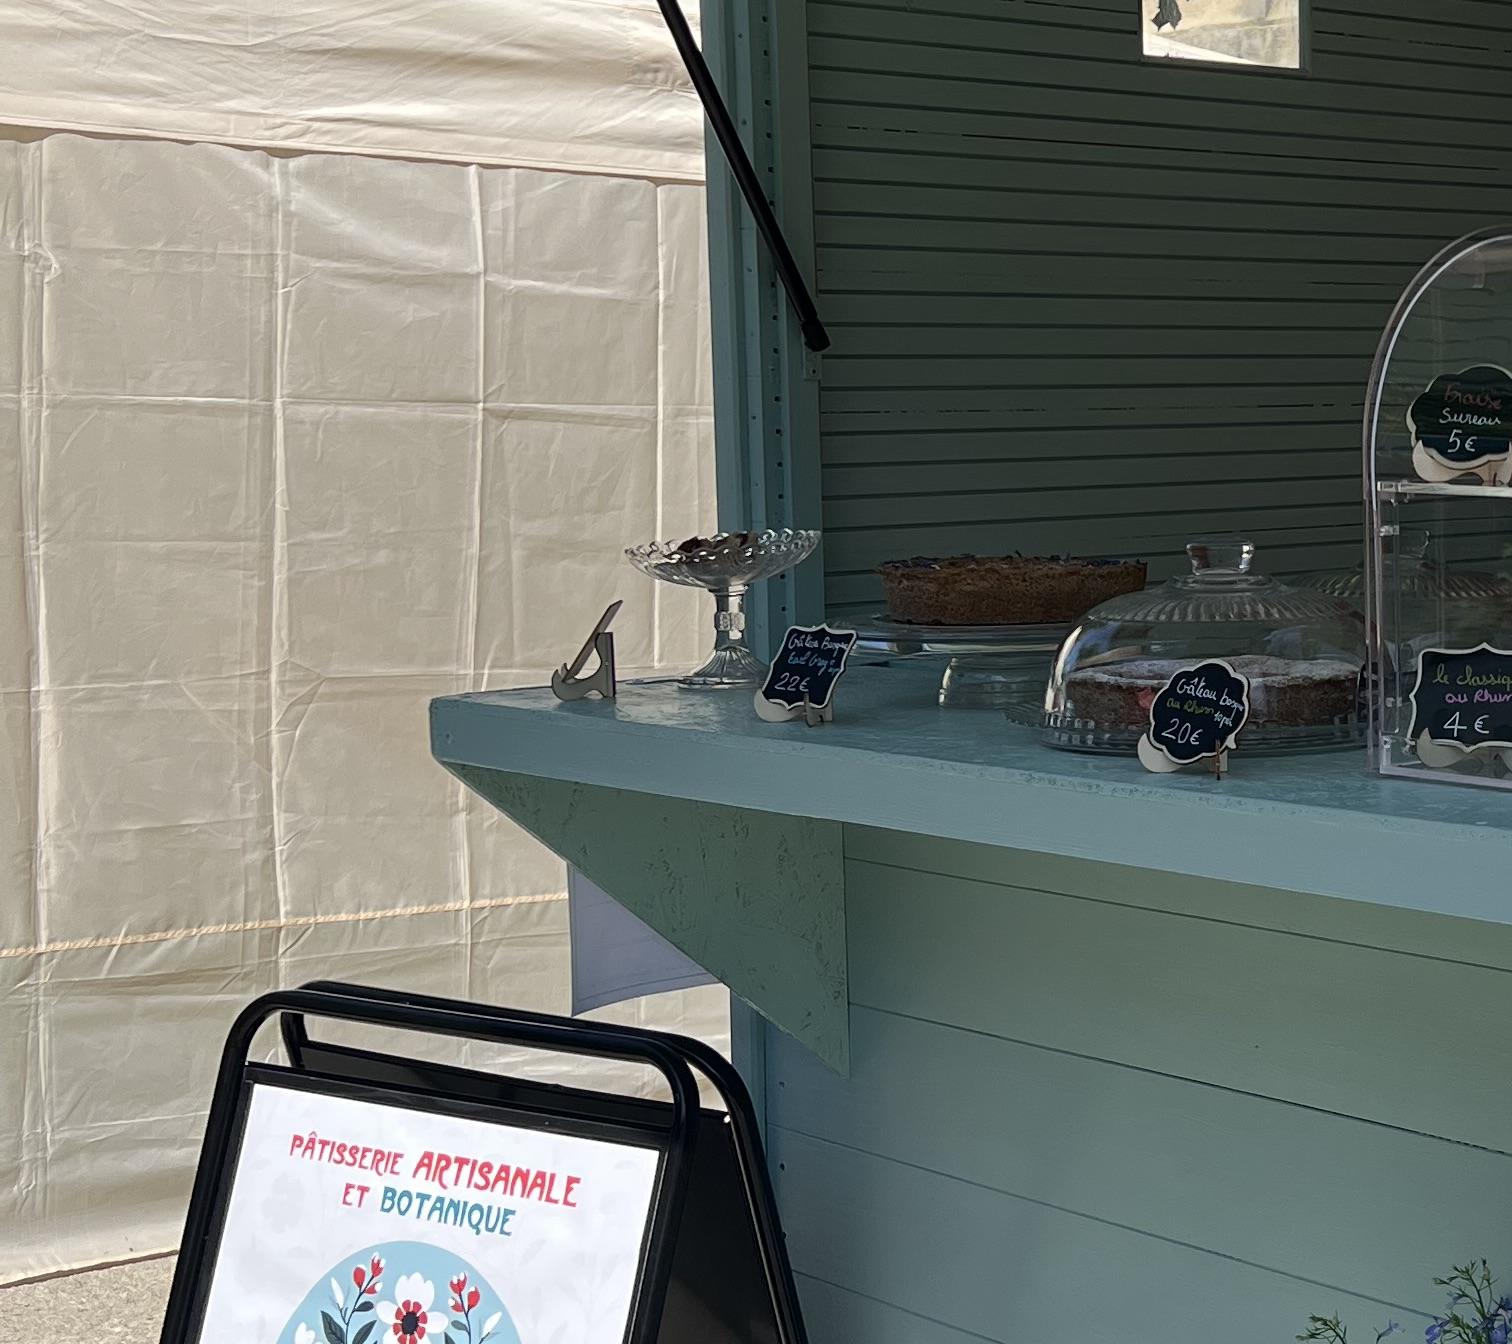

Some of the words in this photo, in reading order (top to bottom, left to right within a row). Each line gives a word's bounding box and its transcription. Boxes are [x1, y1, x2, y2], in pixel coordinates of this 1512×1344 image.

[1439, 407, 1501, 426] Sureau
[774, 672, 811, 692] 22€
[1445, 693, 1468, 704] au
[1161, 718, 1204, 745] 20€
[289, 1131, 404, 1176] PÂTISSERIE
[412, 1150, 581, 1208] ARTISANALE
[342, 1182, 370, 1208] ET
[379, 1186, 517, 1236] BOTANIQUE
